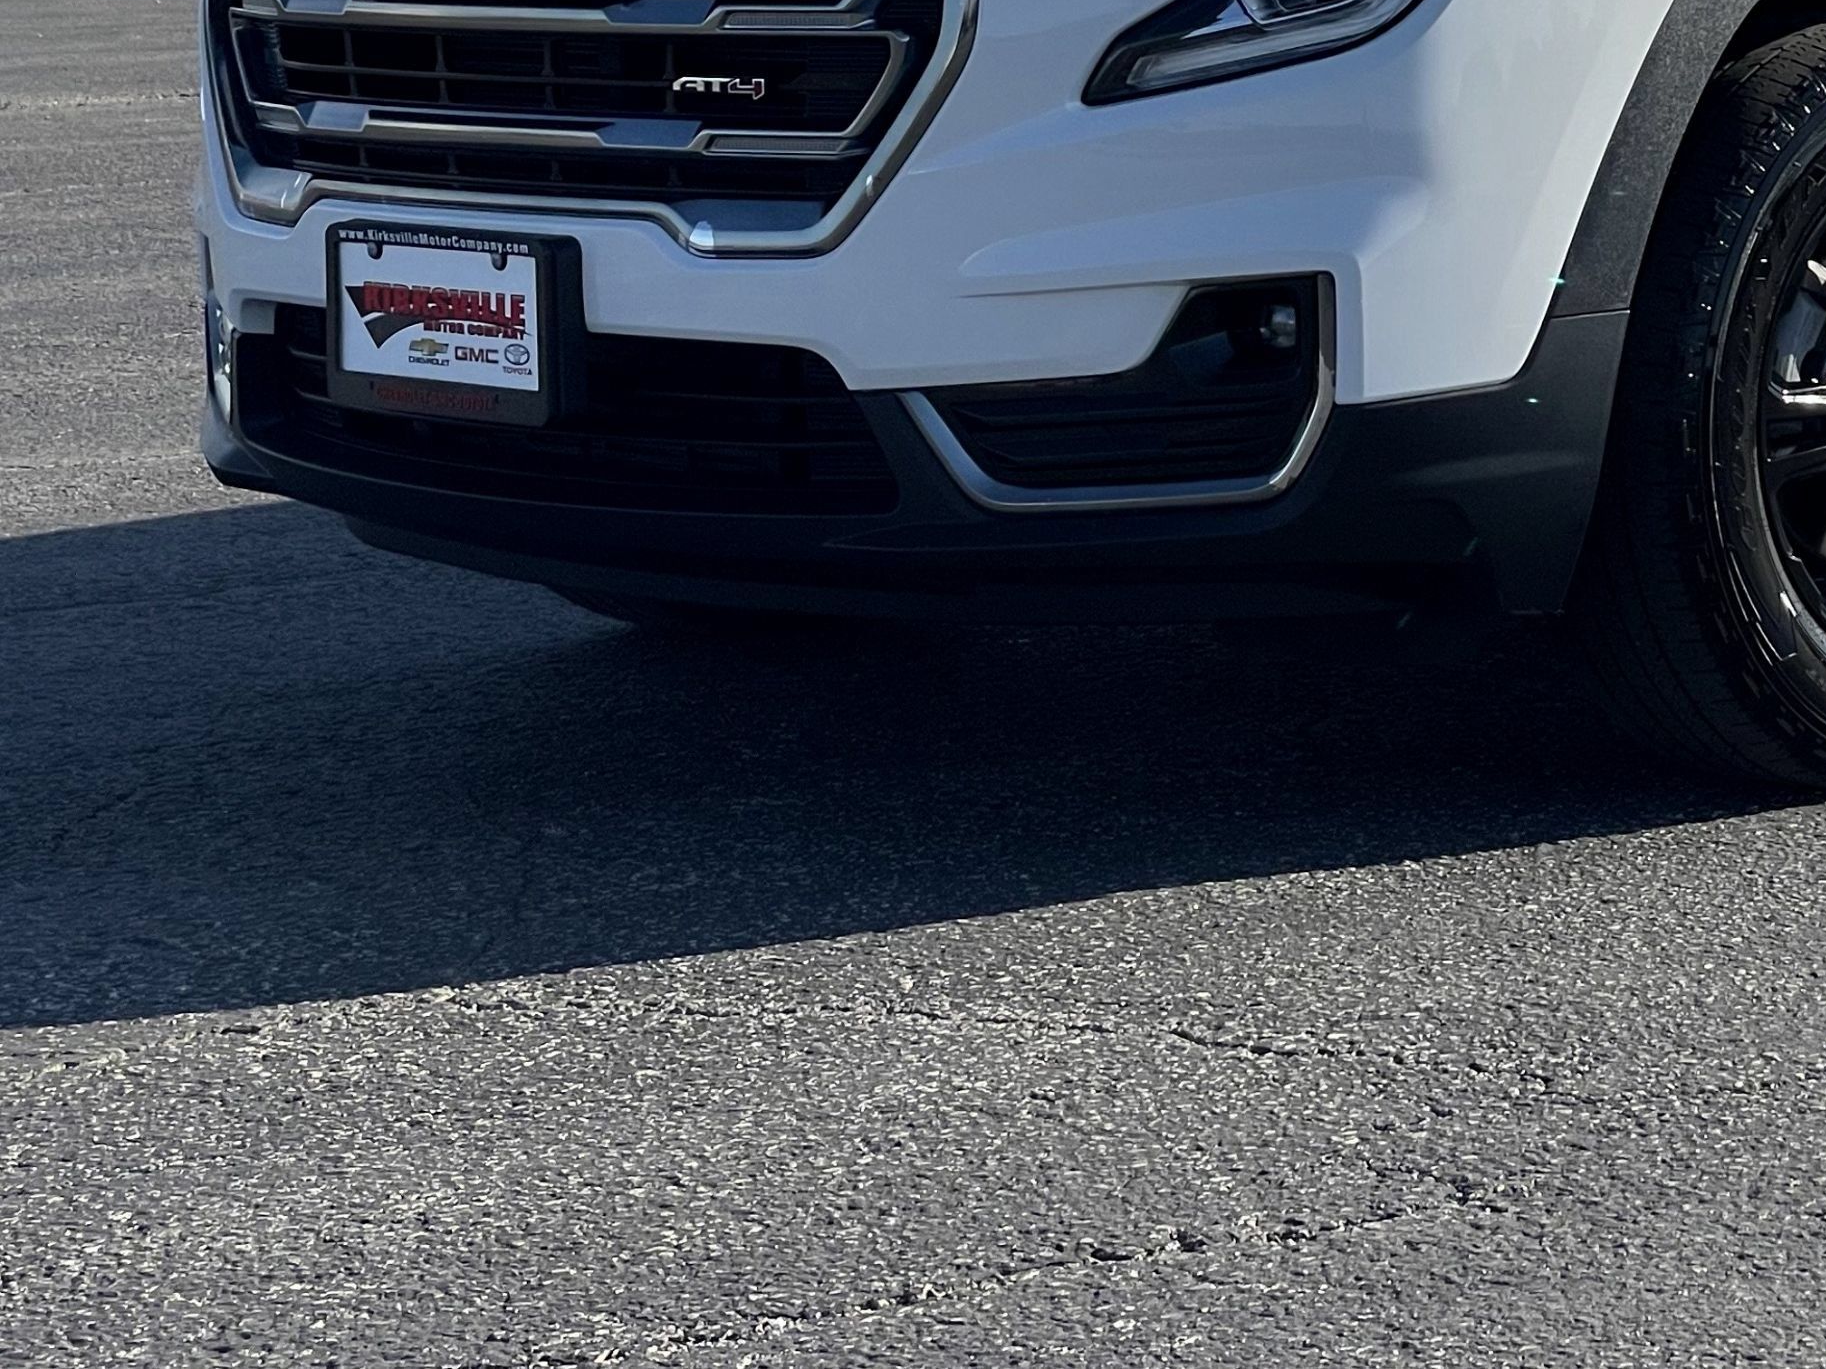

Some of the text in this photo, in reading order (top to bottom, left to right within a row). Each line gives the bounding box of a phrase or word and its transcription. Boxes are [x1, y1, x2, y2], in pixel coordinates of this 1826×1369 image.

[672, 76, 765, 101] AT4
[338, 229, 529, 254] www.KirksvilleMotorCompany.com
[363, 281, 526, 329] KIRKSVILLE
[408, 355, 450, 366] CHEVROLET
[454, 346, 499, 364] GMC
[502, 366, 533, 376] TOYOTA
